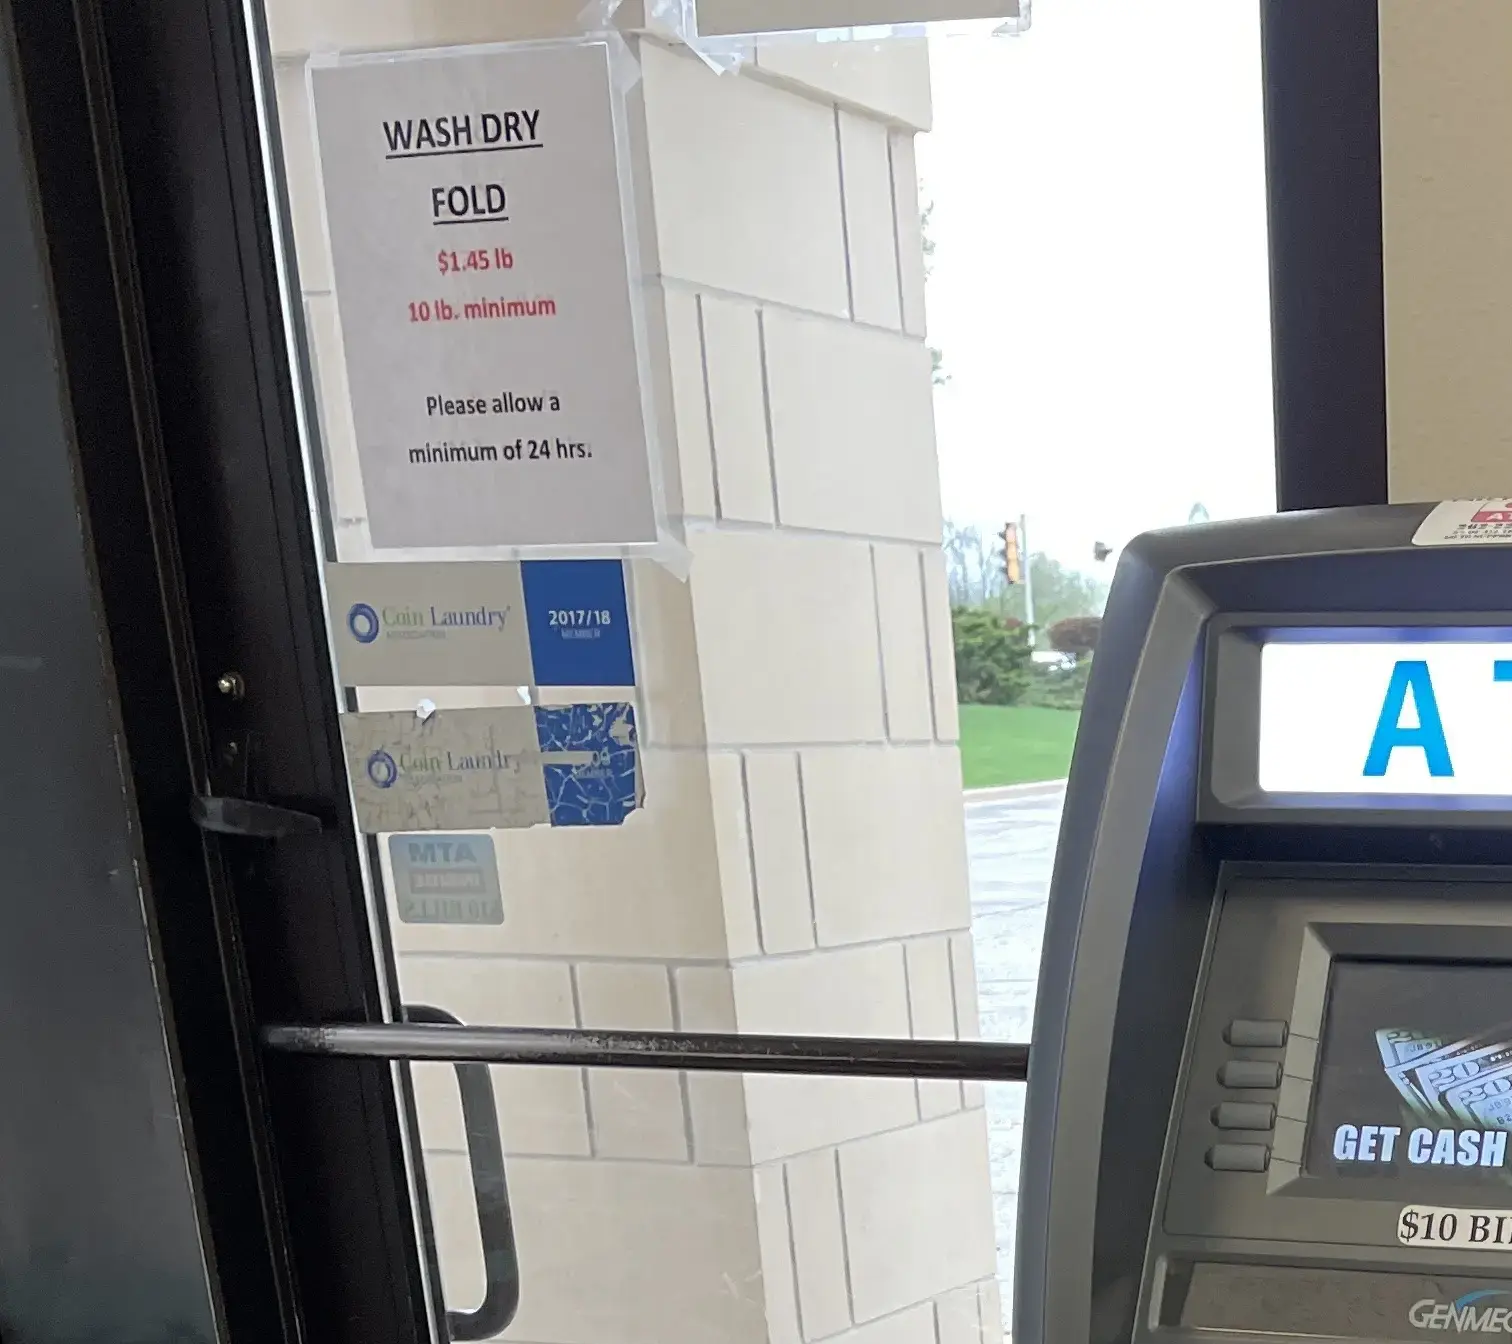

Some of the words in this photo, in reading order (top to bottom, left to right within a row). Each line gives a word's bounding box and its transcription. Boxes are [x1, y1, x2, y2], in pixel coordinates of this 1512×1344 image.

[383, 115, 473, 151] WASH
[481, 110, 541, 145] DRY
[431, 184, 507, 218] FOLD
[437, 249, 490, 275] $1.45
[494, 247, 513, 270] lb
[408, 301, 431, 322] 10
[433, 300, 461, 321] lb.
[464, 297, 557, 319] minimum
[426, 394, 487, 416] Please
[491, 392, 544, 414] allow
[548, 397, 561, 413] a
[409, 441, 498, 464] minimum
[503, 439, 523, 461] of
[528, 439, 552, 460] 24
[556, 438, 593, 460] hrs.
[382, 606, 424, 627] Coin
[430, 606, 508, 632] Laundry
[548, 610, 611, 626] 2017/18
[1458, 1080, 1512, 1106] 20
[1333, 1124, 1401, 1163] GET
[1407, 1127, 1508, 1168] CASH
[1400, 1208, 1458, 1243] $10
